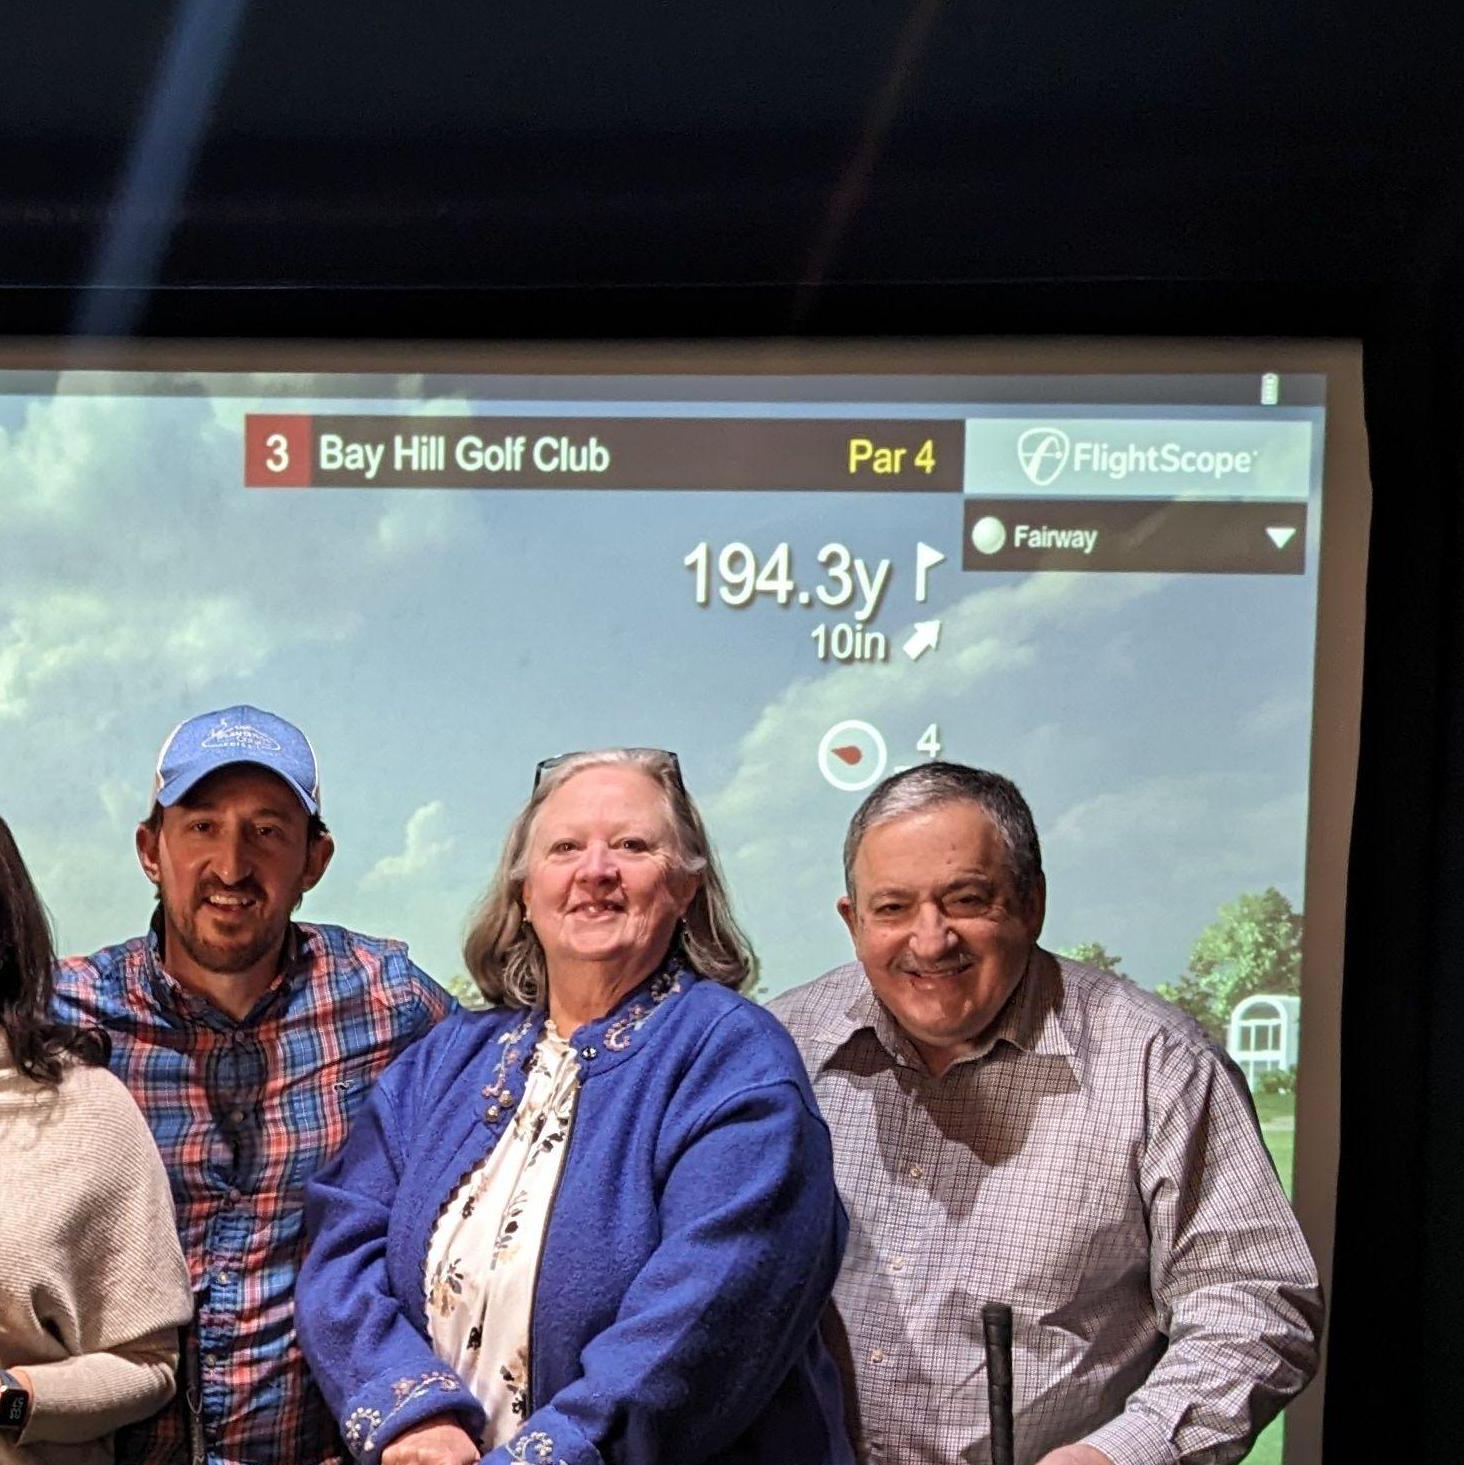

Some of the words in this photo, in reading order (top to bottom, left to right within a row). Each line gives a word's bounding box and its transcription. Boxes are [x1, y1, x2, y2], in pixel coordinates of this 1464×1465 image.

[265, 433, 290, 472] 3
[319, 433, 385, 479] Bay
[393, 434, 446, 471] Hill
[455, 434, 527, 472] Golf
[533, 435, 611, 472] Club
[848, 439, 905, 474] Par
[914, 440, 936, 473] 4
[1074, 442, 1252, 479] FlightScope
[1014, 525, 1098, 552] Fairway
[683, 541, 891, 621] 194.3y
[810, 622, 887, 660] 10in
[916, 722, 941, 758] 4
